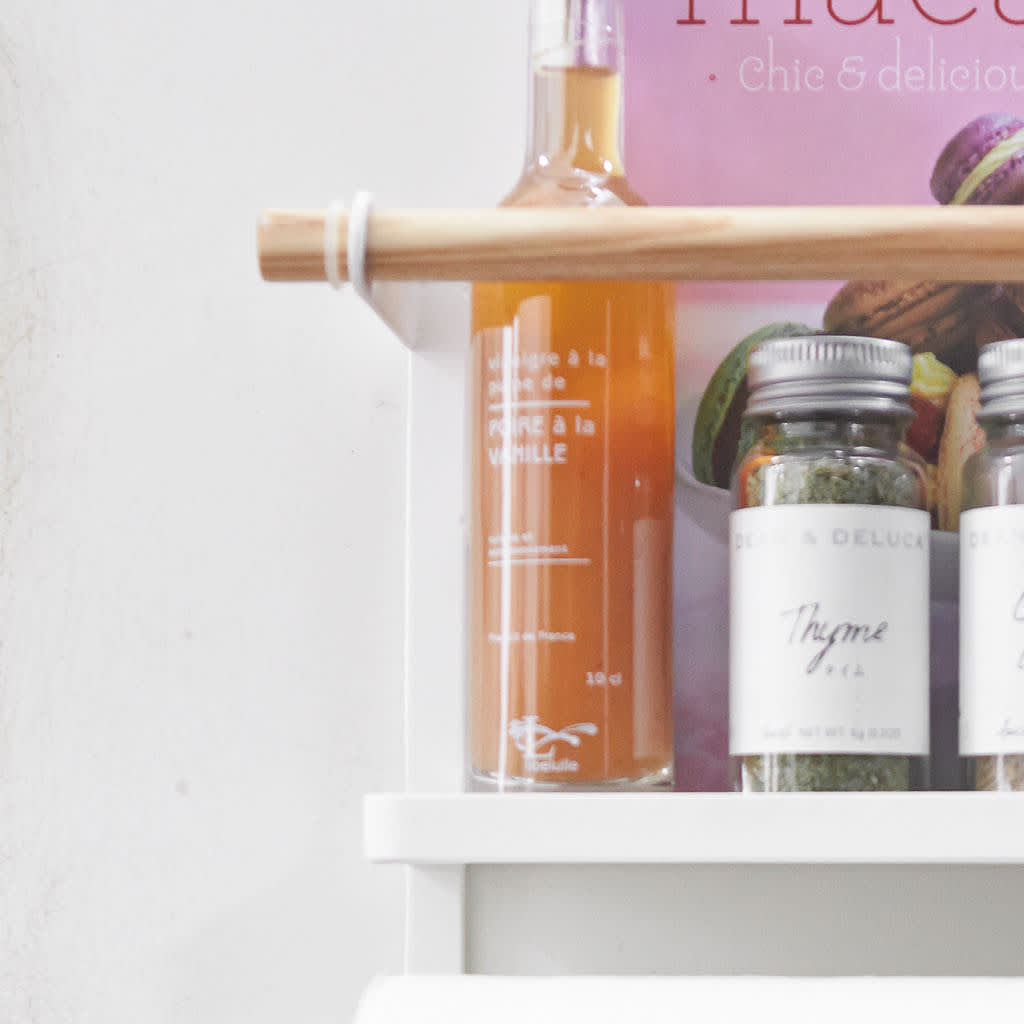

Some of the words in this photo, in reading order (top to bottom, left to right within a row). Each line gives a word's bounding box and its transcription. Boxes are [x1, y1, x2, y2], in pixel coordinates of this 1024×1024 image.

[738, 36, 825, 91] Chic
[837, 55, 866, 91] &
[780, 601, 889, 675] Thyme
